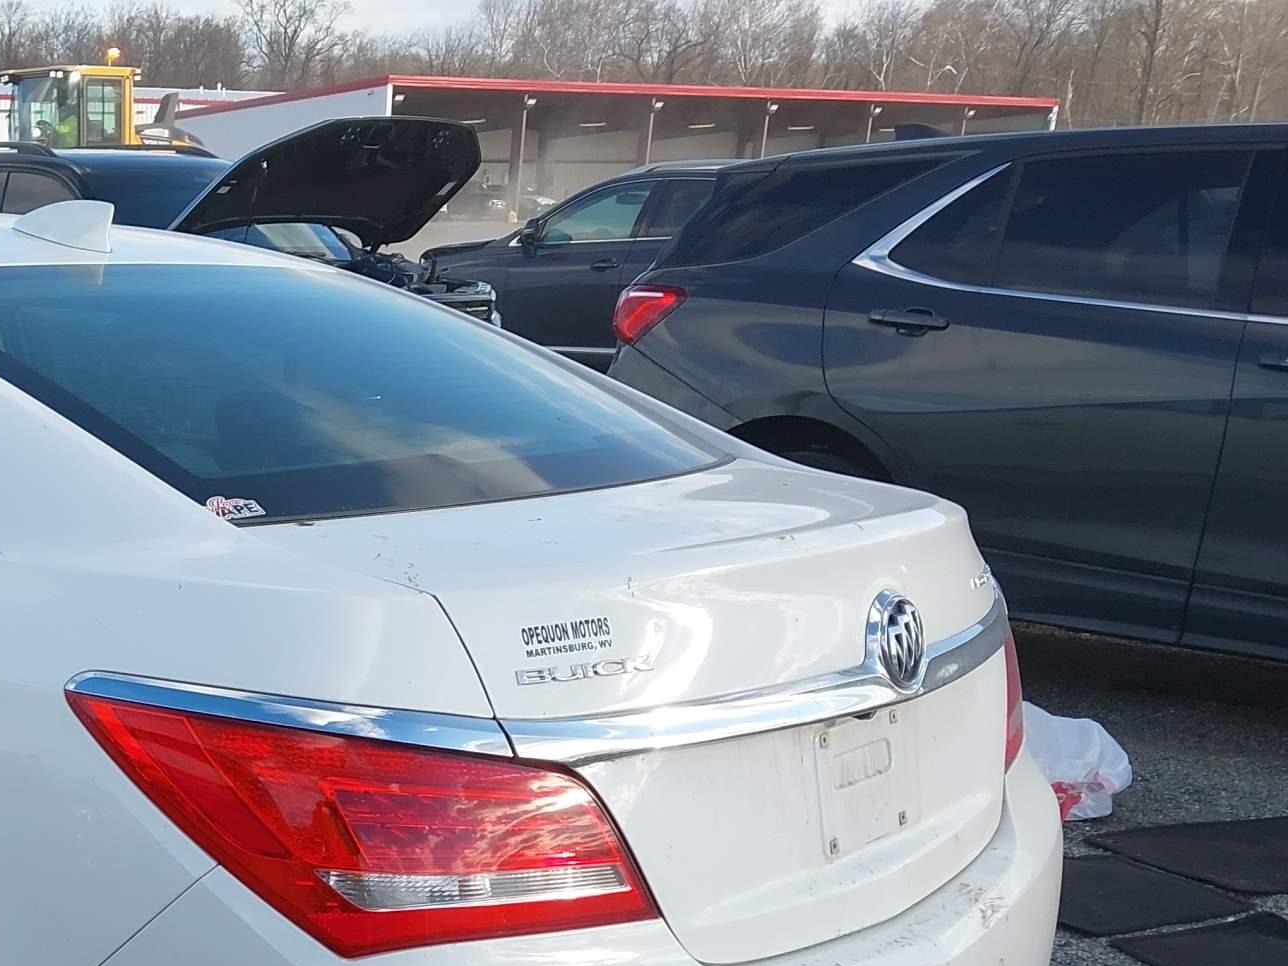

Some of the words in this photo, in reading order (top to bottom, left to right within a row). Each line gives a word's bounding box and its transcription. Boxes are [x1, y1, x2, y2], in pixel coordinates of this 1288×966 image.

[521, 622, 571, 646] OPEQUON
[571, 617, 611, 638] MOTORS
[526, 642, 598, 658] MARTINSBURG,
[599, 640, 613, 649] WV
[515, 656, 655, 686] BUICK
